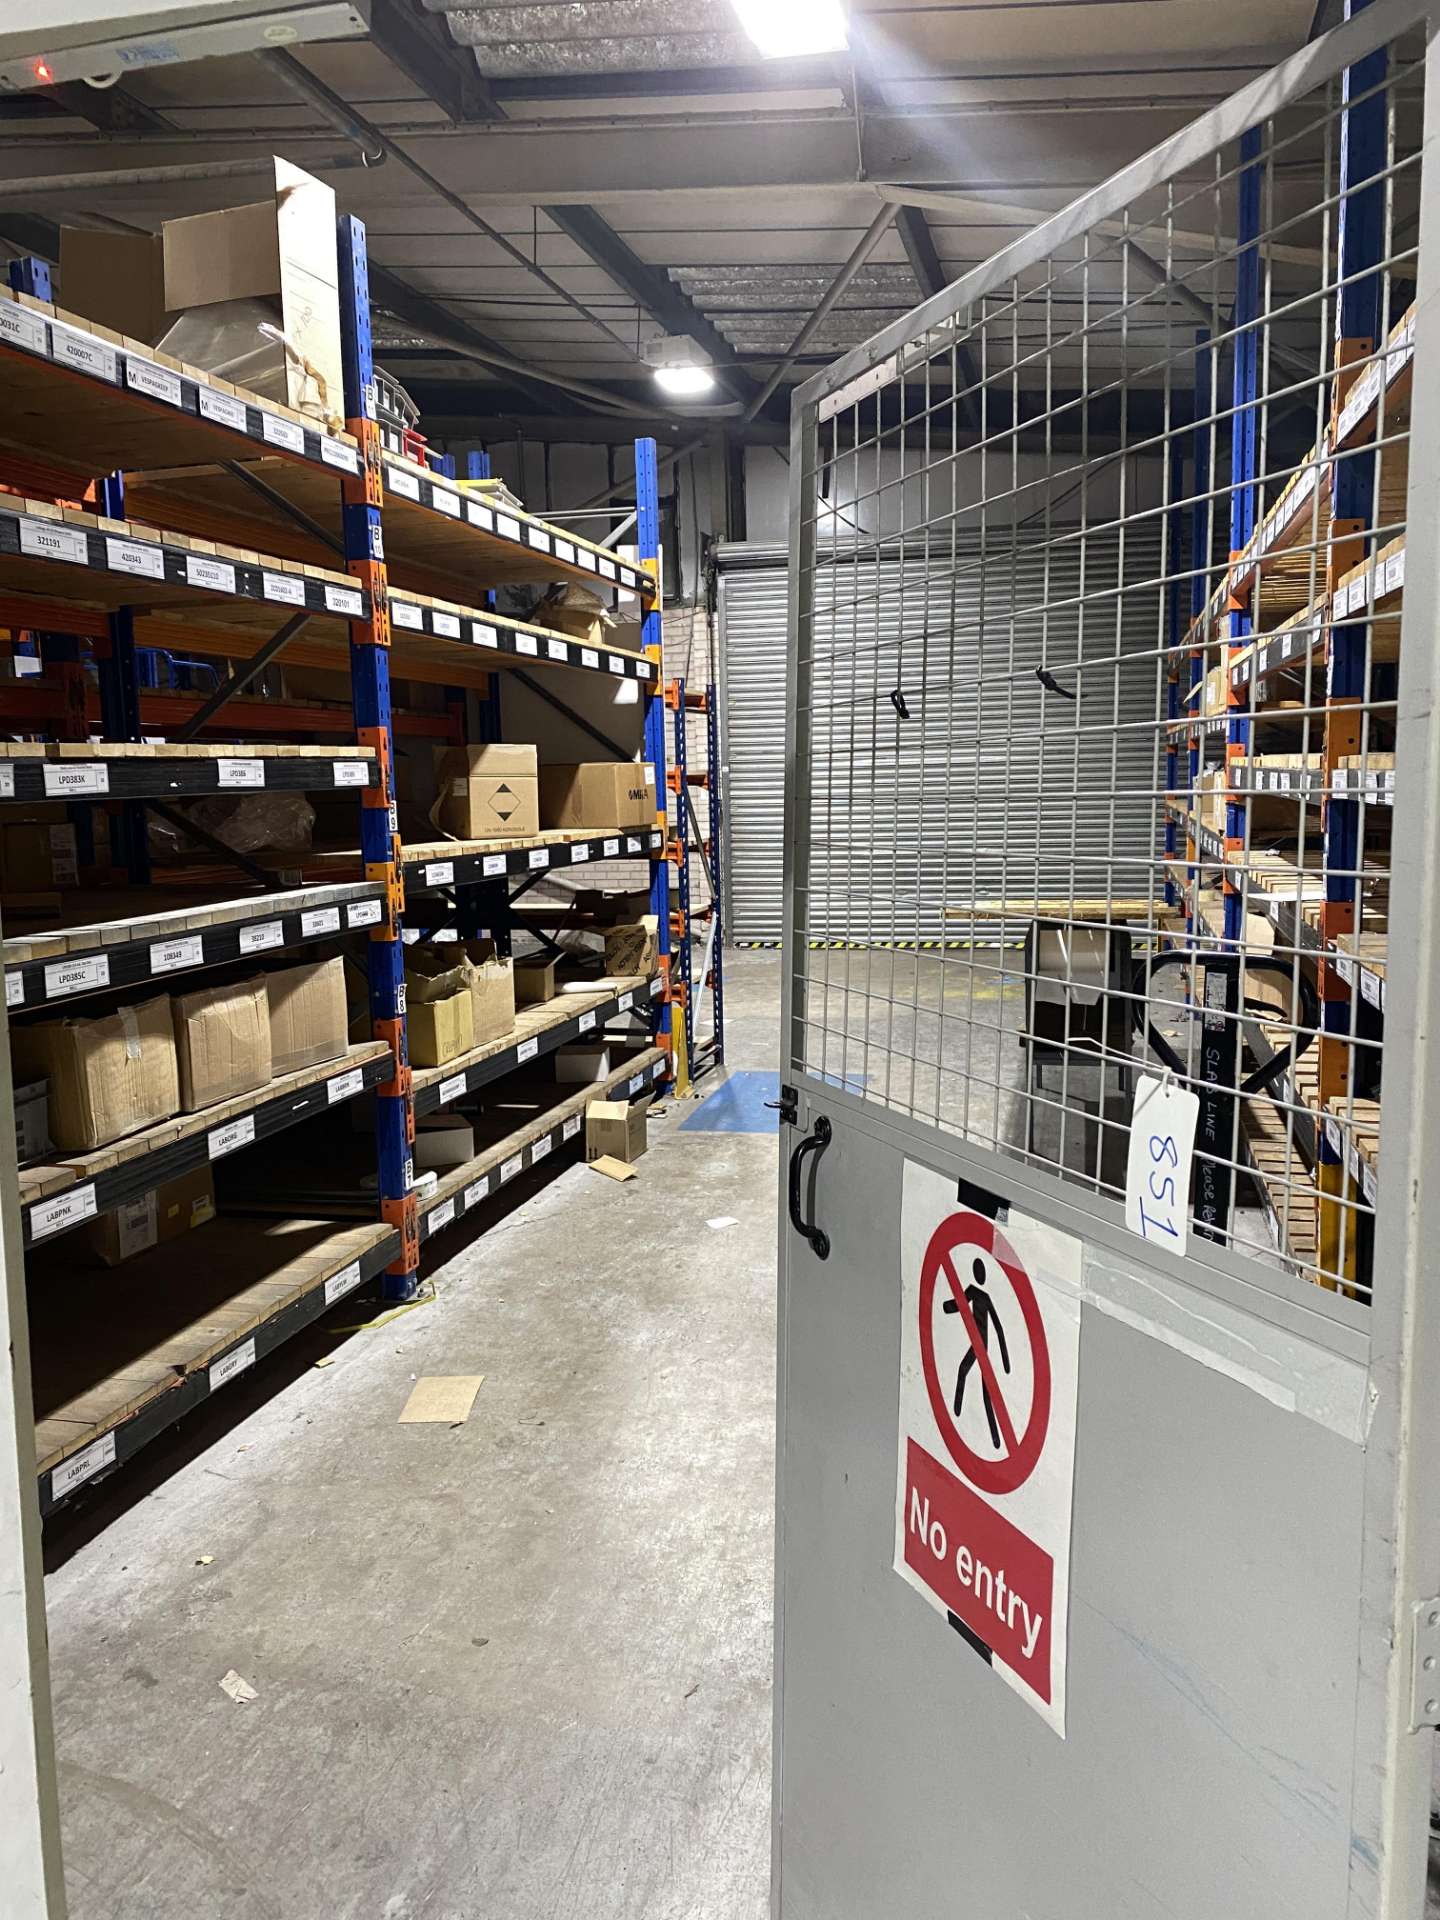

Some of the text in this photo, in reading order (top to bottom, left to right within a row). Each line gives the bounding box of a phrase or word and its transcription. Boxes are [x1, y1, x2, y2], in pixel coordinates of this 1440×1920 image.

[128, 371, 137, 384] M
[367, 387, 374, 401] B
[201, 399, 208, 411] M
[374, 527, 380, 540] B
[58, 775, 86, 785] LPD383K
[399, 984, 405, 1012] B 8
[1205, 1102, 1217, 1142] LINE
[1139, 1135, 1178, 1237] 851
[46, 1205, 72, 1223] LABPNK
[910, 1486, 1043, 1660] No entry
